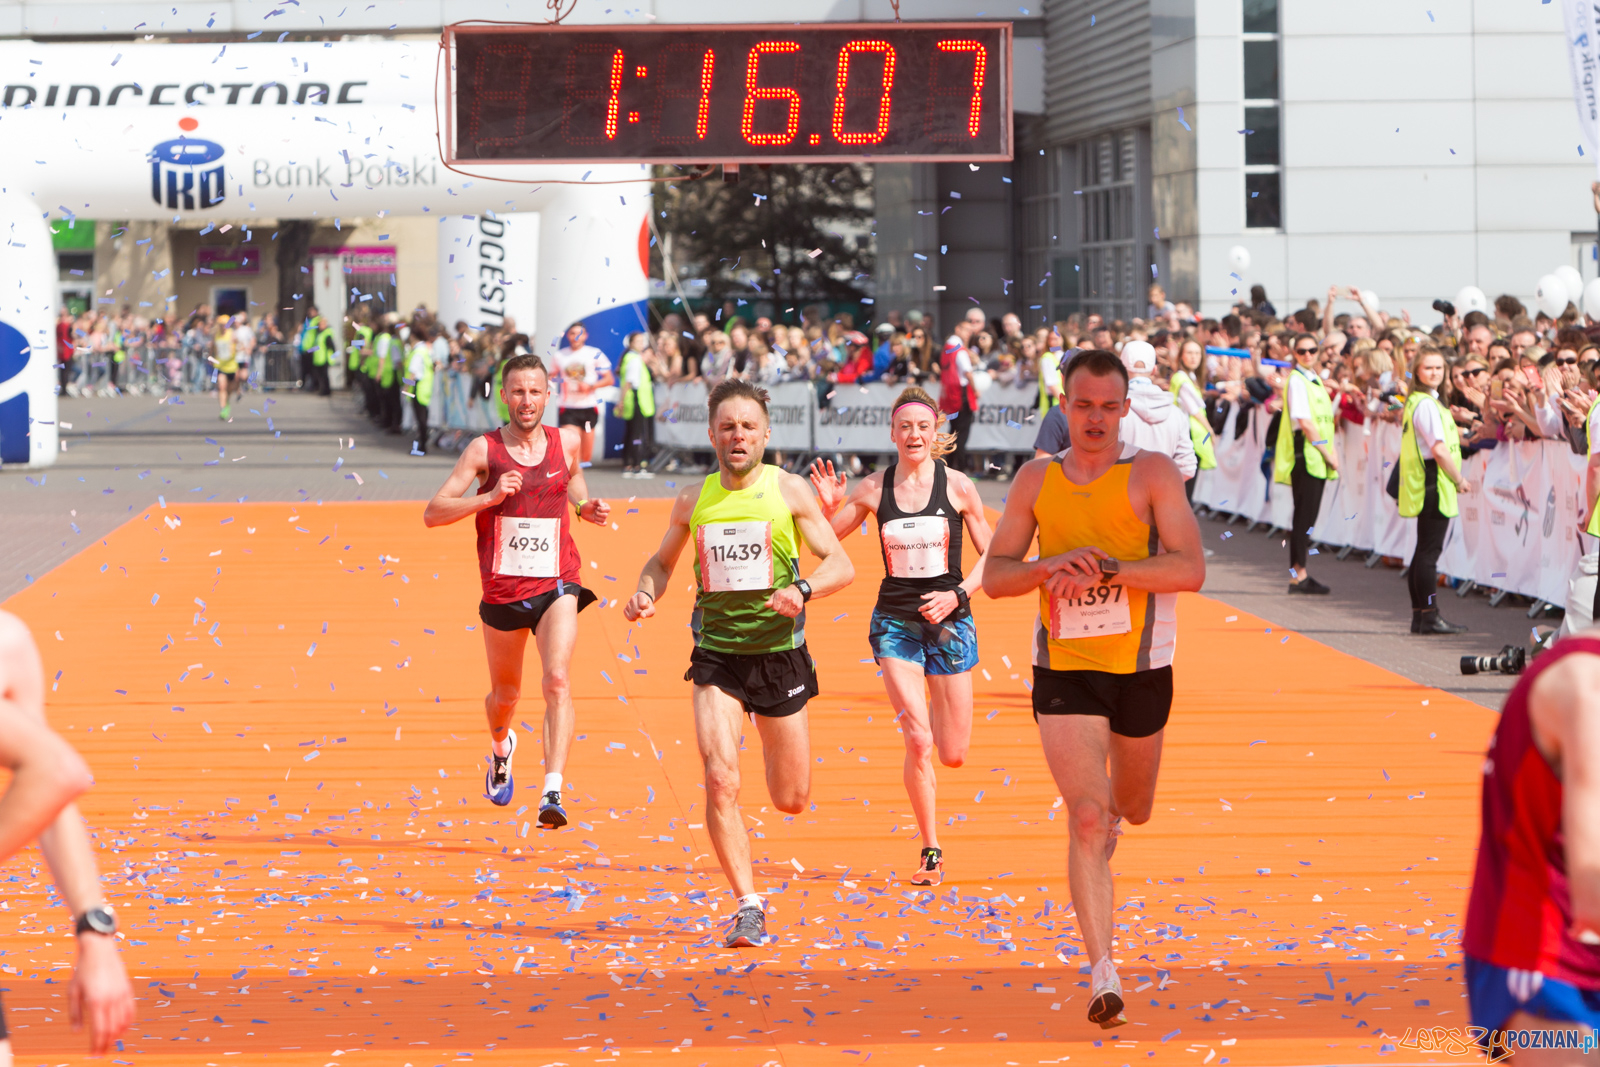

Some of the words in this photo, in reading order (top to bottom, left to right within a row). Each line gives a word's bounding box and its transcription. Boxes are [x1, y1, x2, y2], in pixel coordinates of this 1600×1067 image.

[252, 158, 332, 188] Bank
[348, 156, 438, 187] Polski
[479, 216, 505, 328] DGEST
[508, 536, 549, 552] 4936
[710, 543, 762, 562] 11439
[888, 541, 942, 551] NOWAKOWSKA
[1080, 609, 1111, 617] Wojciech
